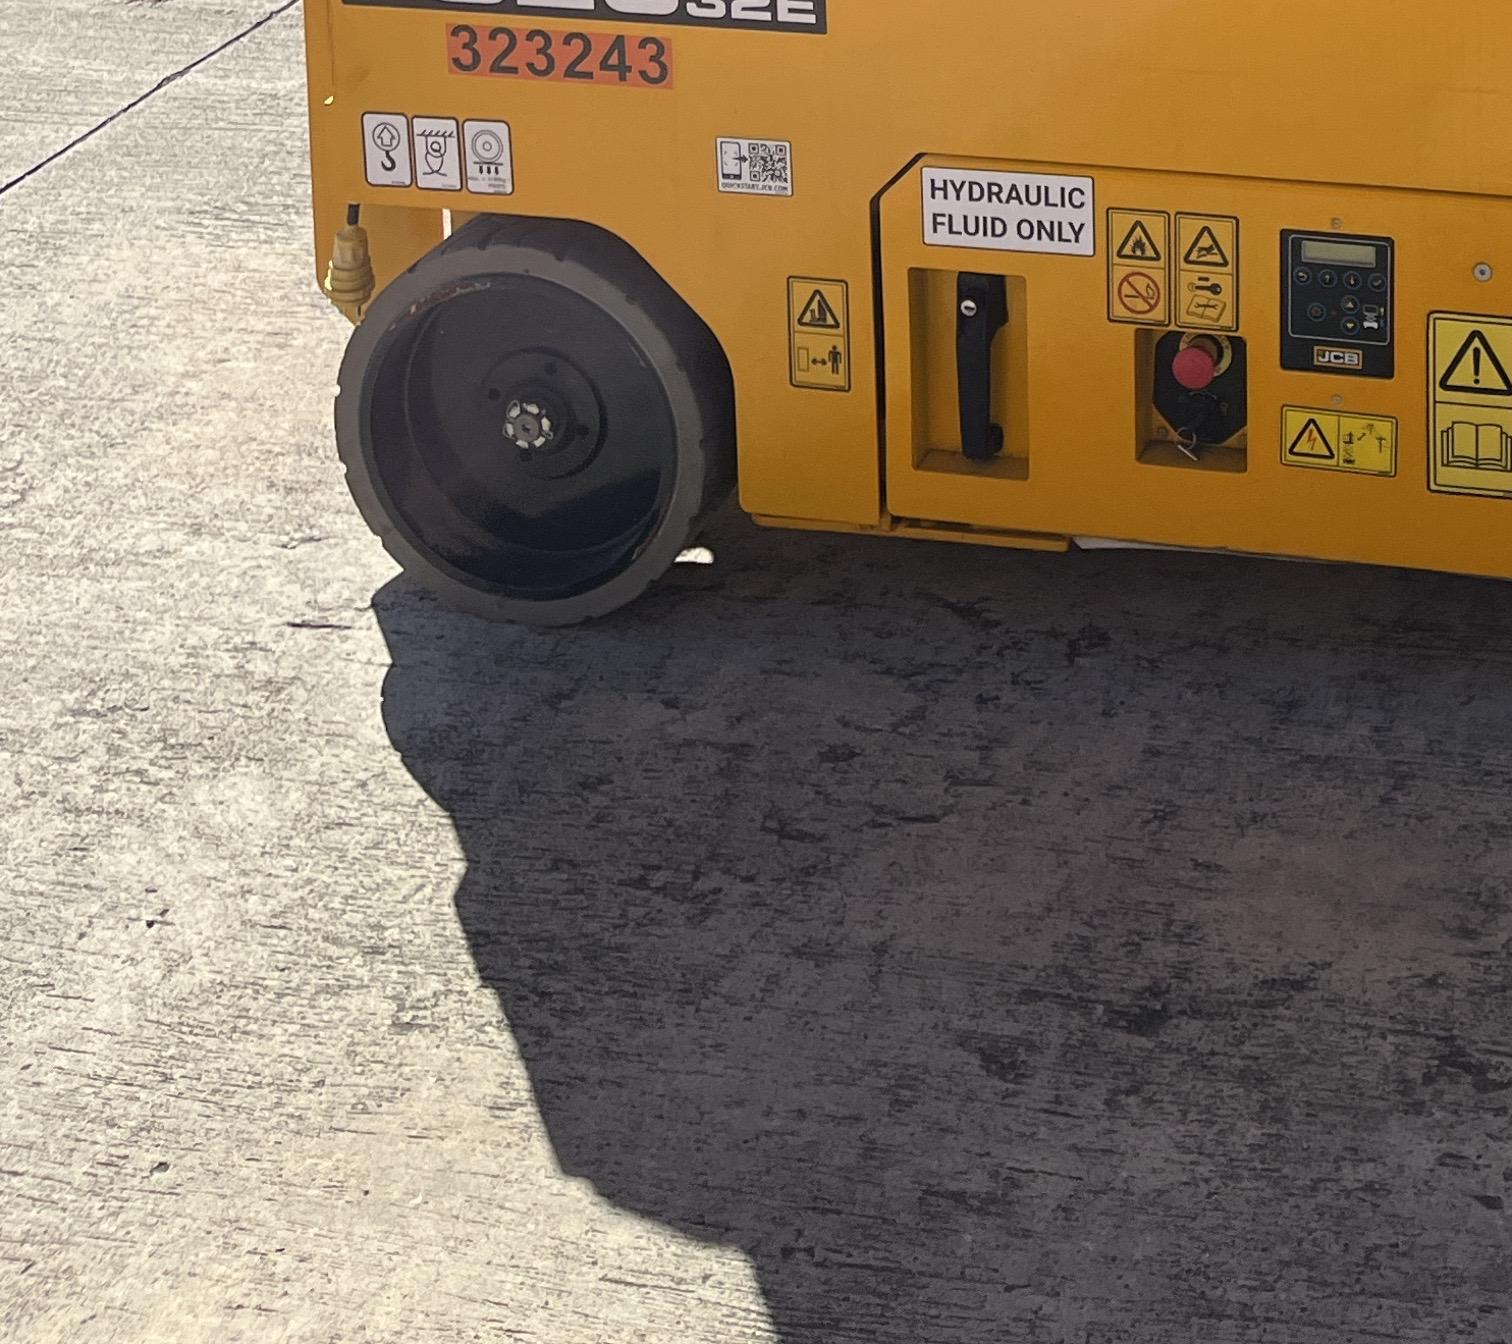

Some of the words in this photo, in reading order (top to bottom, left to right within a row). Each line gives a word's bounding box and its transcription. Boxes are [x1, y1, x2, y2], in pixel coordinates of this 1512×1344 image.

[450, 23, 670, 86] 323243
[929, 178, 1086, 210] HYDRAULIC
[931, 212, 1008, 239] FLUID
[1016, 218, 1086, 244] ONLY
[1317, 351, 1359, 365] JCB
